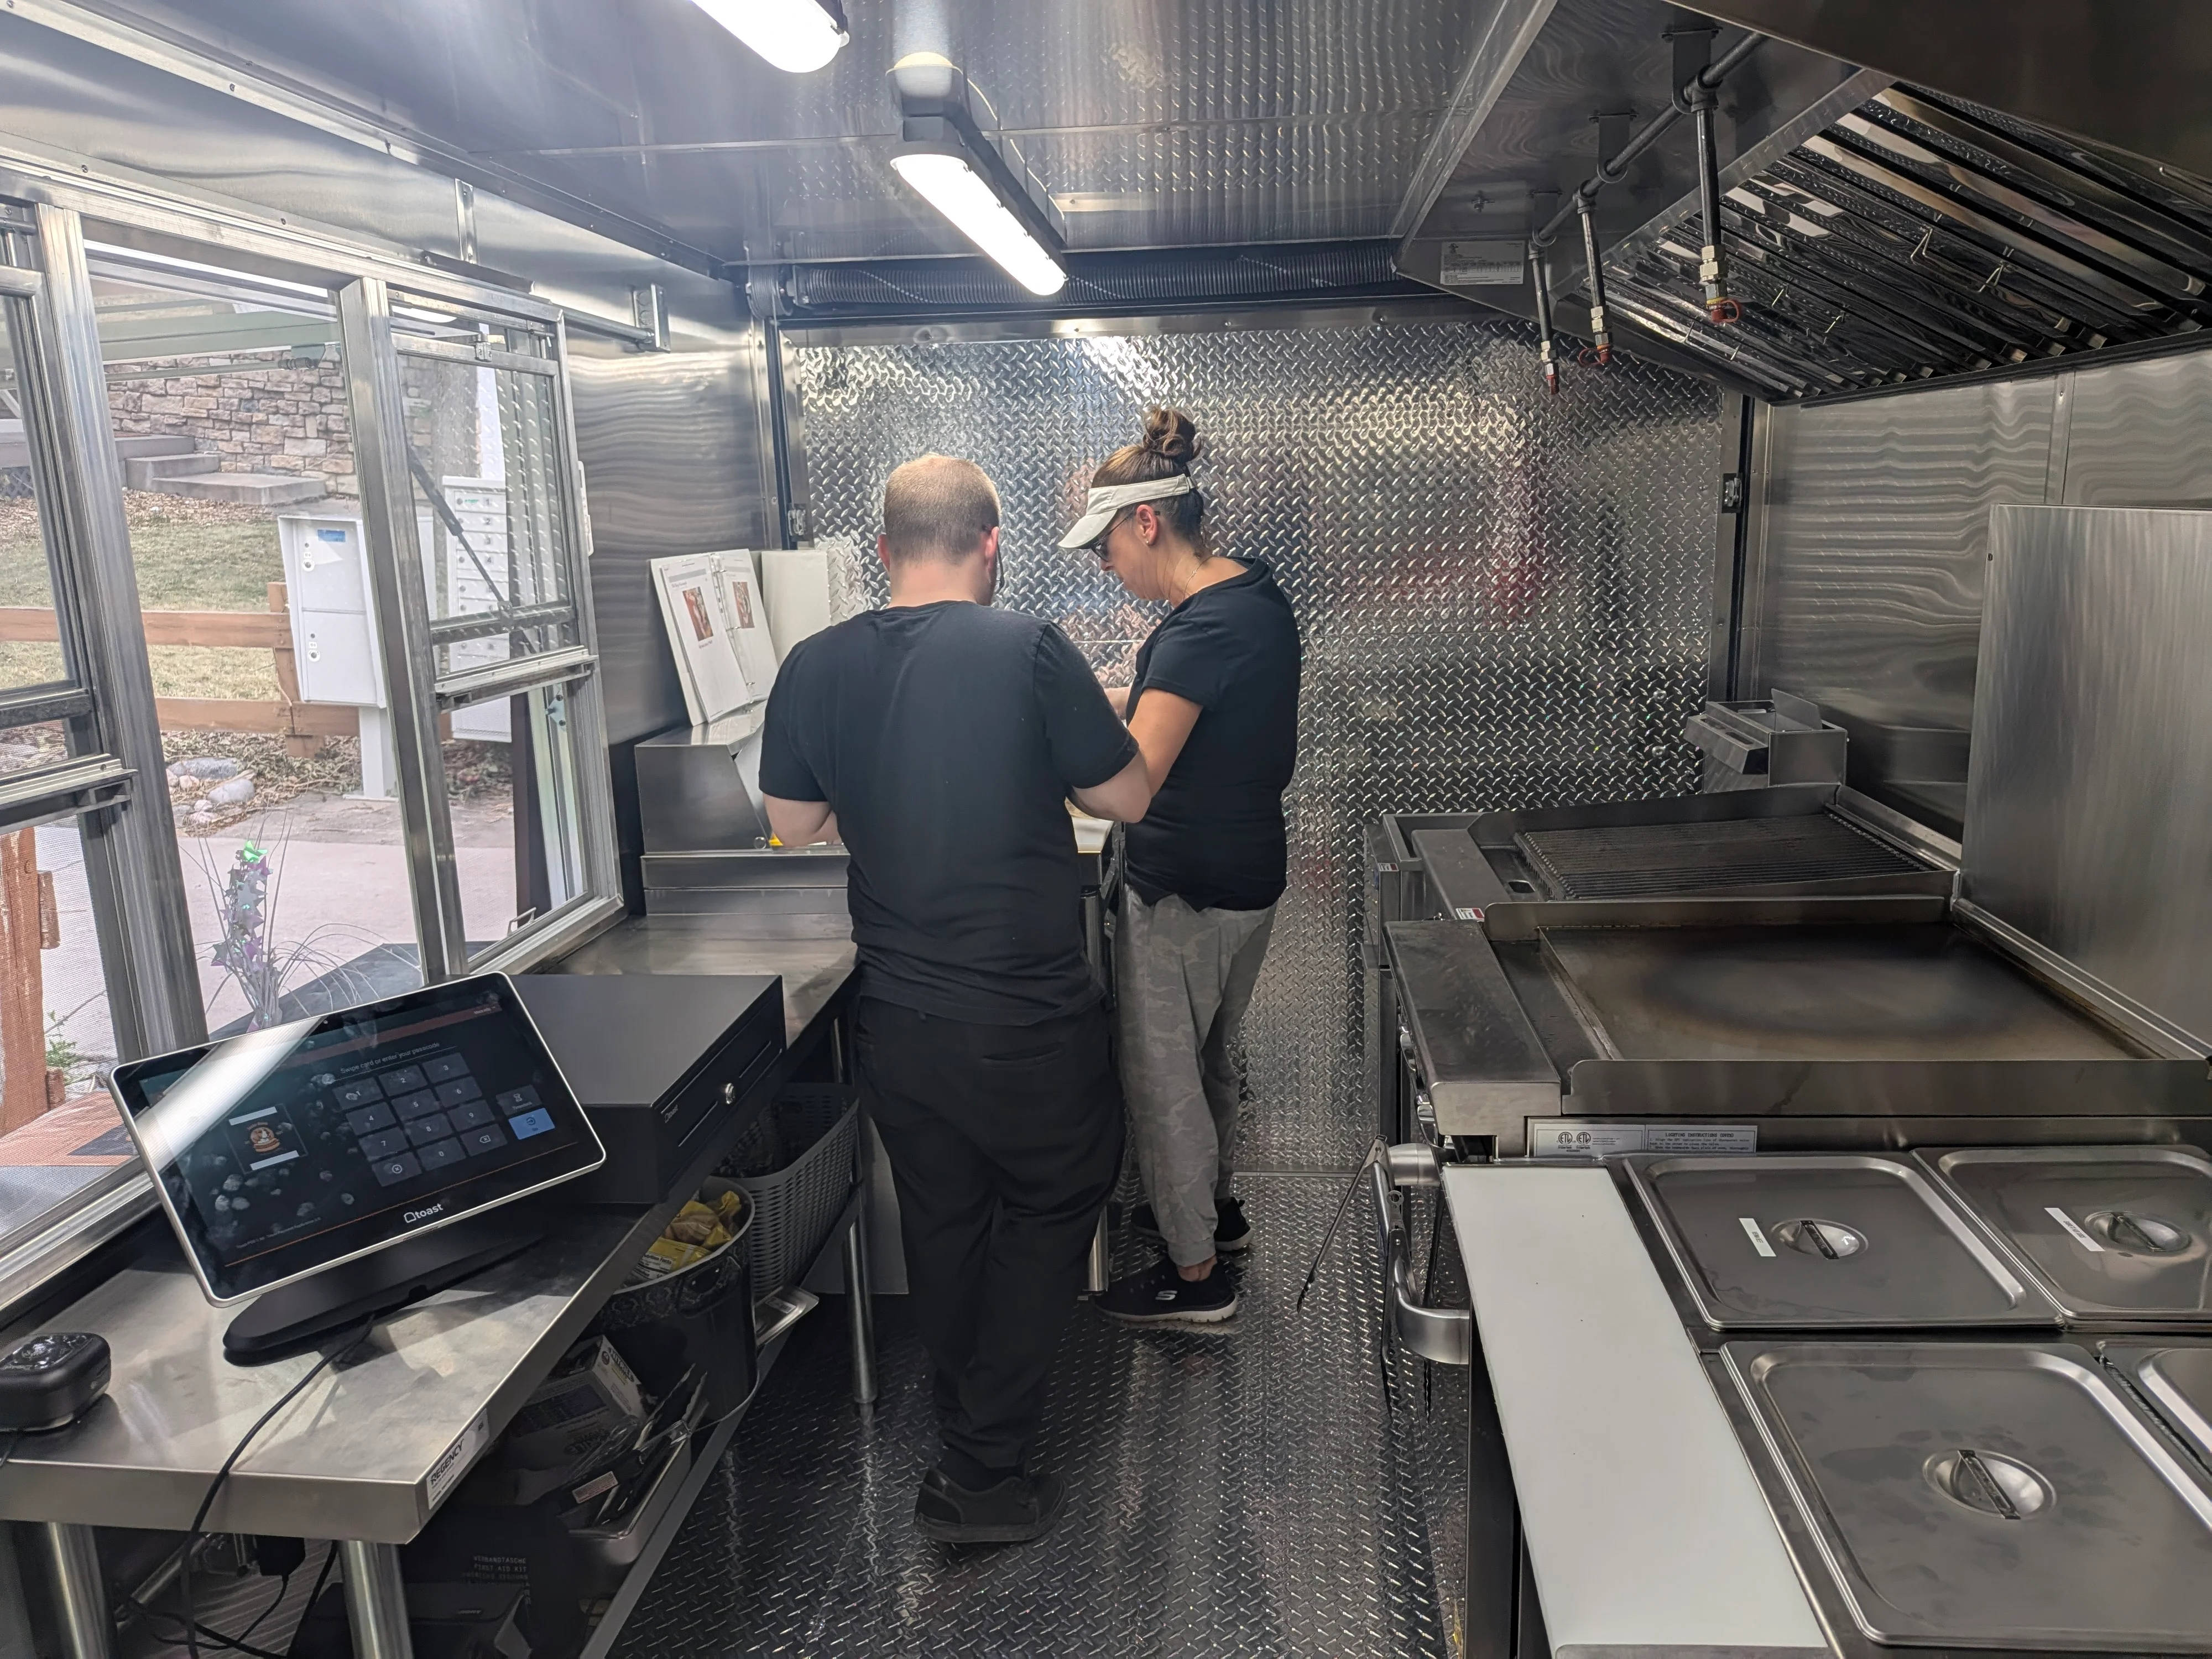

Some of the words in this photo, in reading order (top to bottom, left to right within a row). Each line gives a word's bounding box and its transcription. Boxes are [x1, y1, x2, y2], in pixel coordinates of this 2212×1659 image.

[340, 1065, 359, 1073] Swipe
[360, 1060, 374, 1068] card
[398, 1050, 411, 1059] your
[411, 1042, 440, 1055] passcode
[415, 1203, 444, 1218] toast
[430, 1438, 464, 1485] REGENCY
